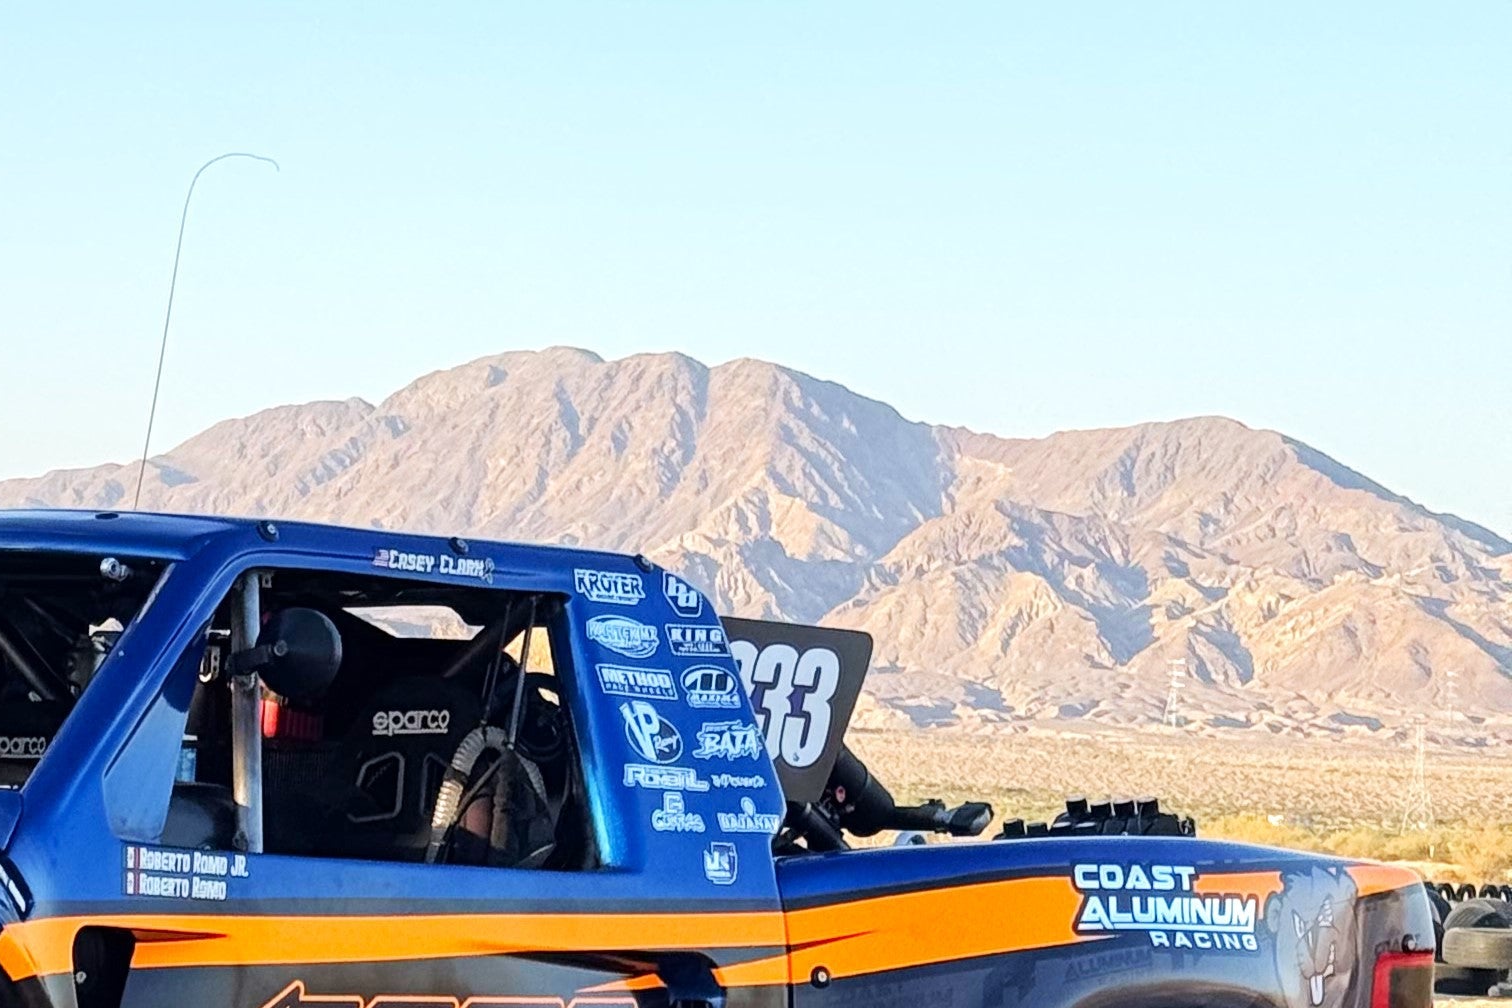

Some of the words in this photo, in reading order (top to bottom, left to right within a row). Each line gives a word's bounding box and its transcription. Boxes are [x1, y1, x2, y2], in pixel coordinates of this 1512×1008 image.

[389, 549, 434, 572] CASEY
[439, 555, 485, 576] CLARK
[671, 628, 723, 642] KING
[601, 668, 672, 689] METHOD
[372, 709, 450, 737] sparco
[619, 700, 660, 761] VP
[699, 728, 758, 756] BAJA
[140, 847, 190, 873] ROBERTO
[193, 852, 228, 876] ROMO
[139, 873, 189, 898] ROBERTO
[192, 876, 227, 900] ROMO
[1074, 864, 1195, 891] COAST
[1078, 896, 1257, 931] ALUMINUM
[1149, 930, 1258, 950] RACING
